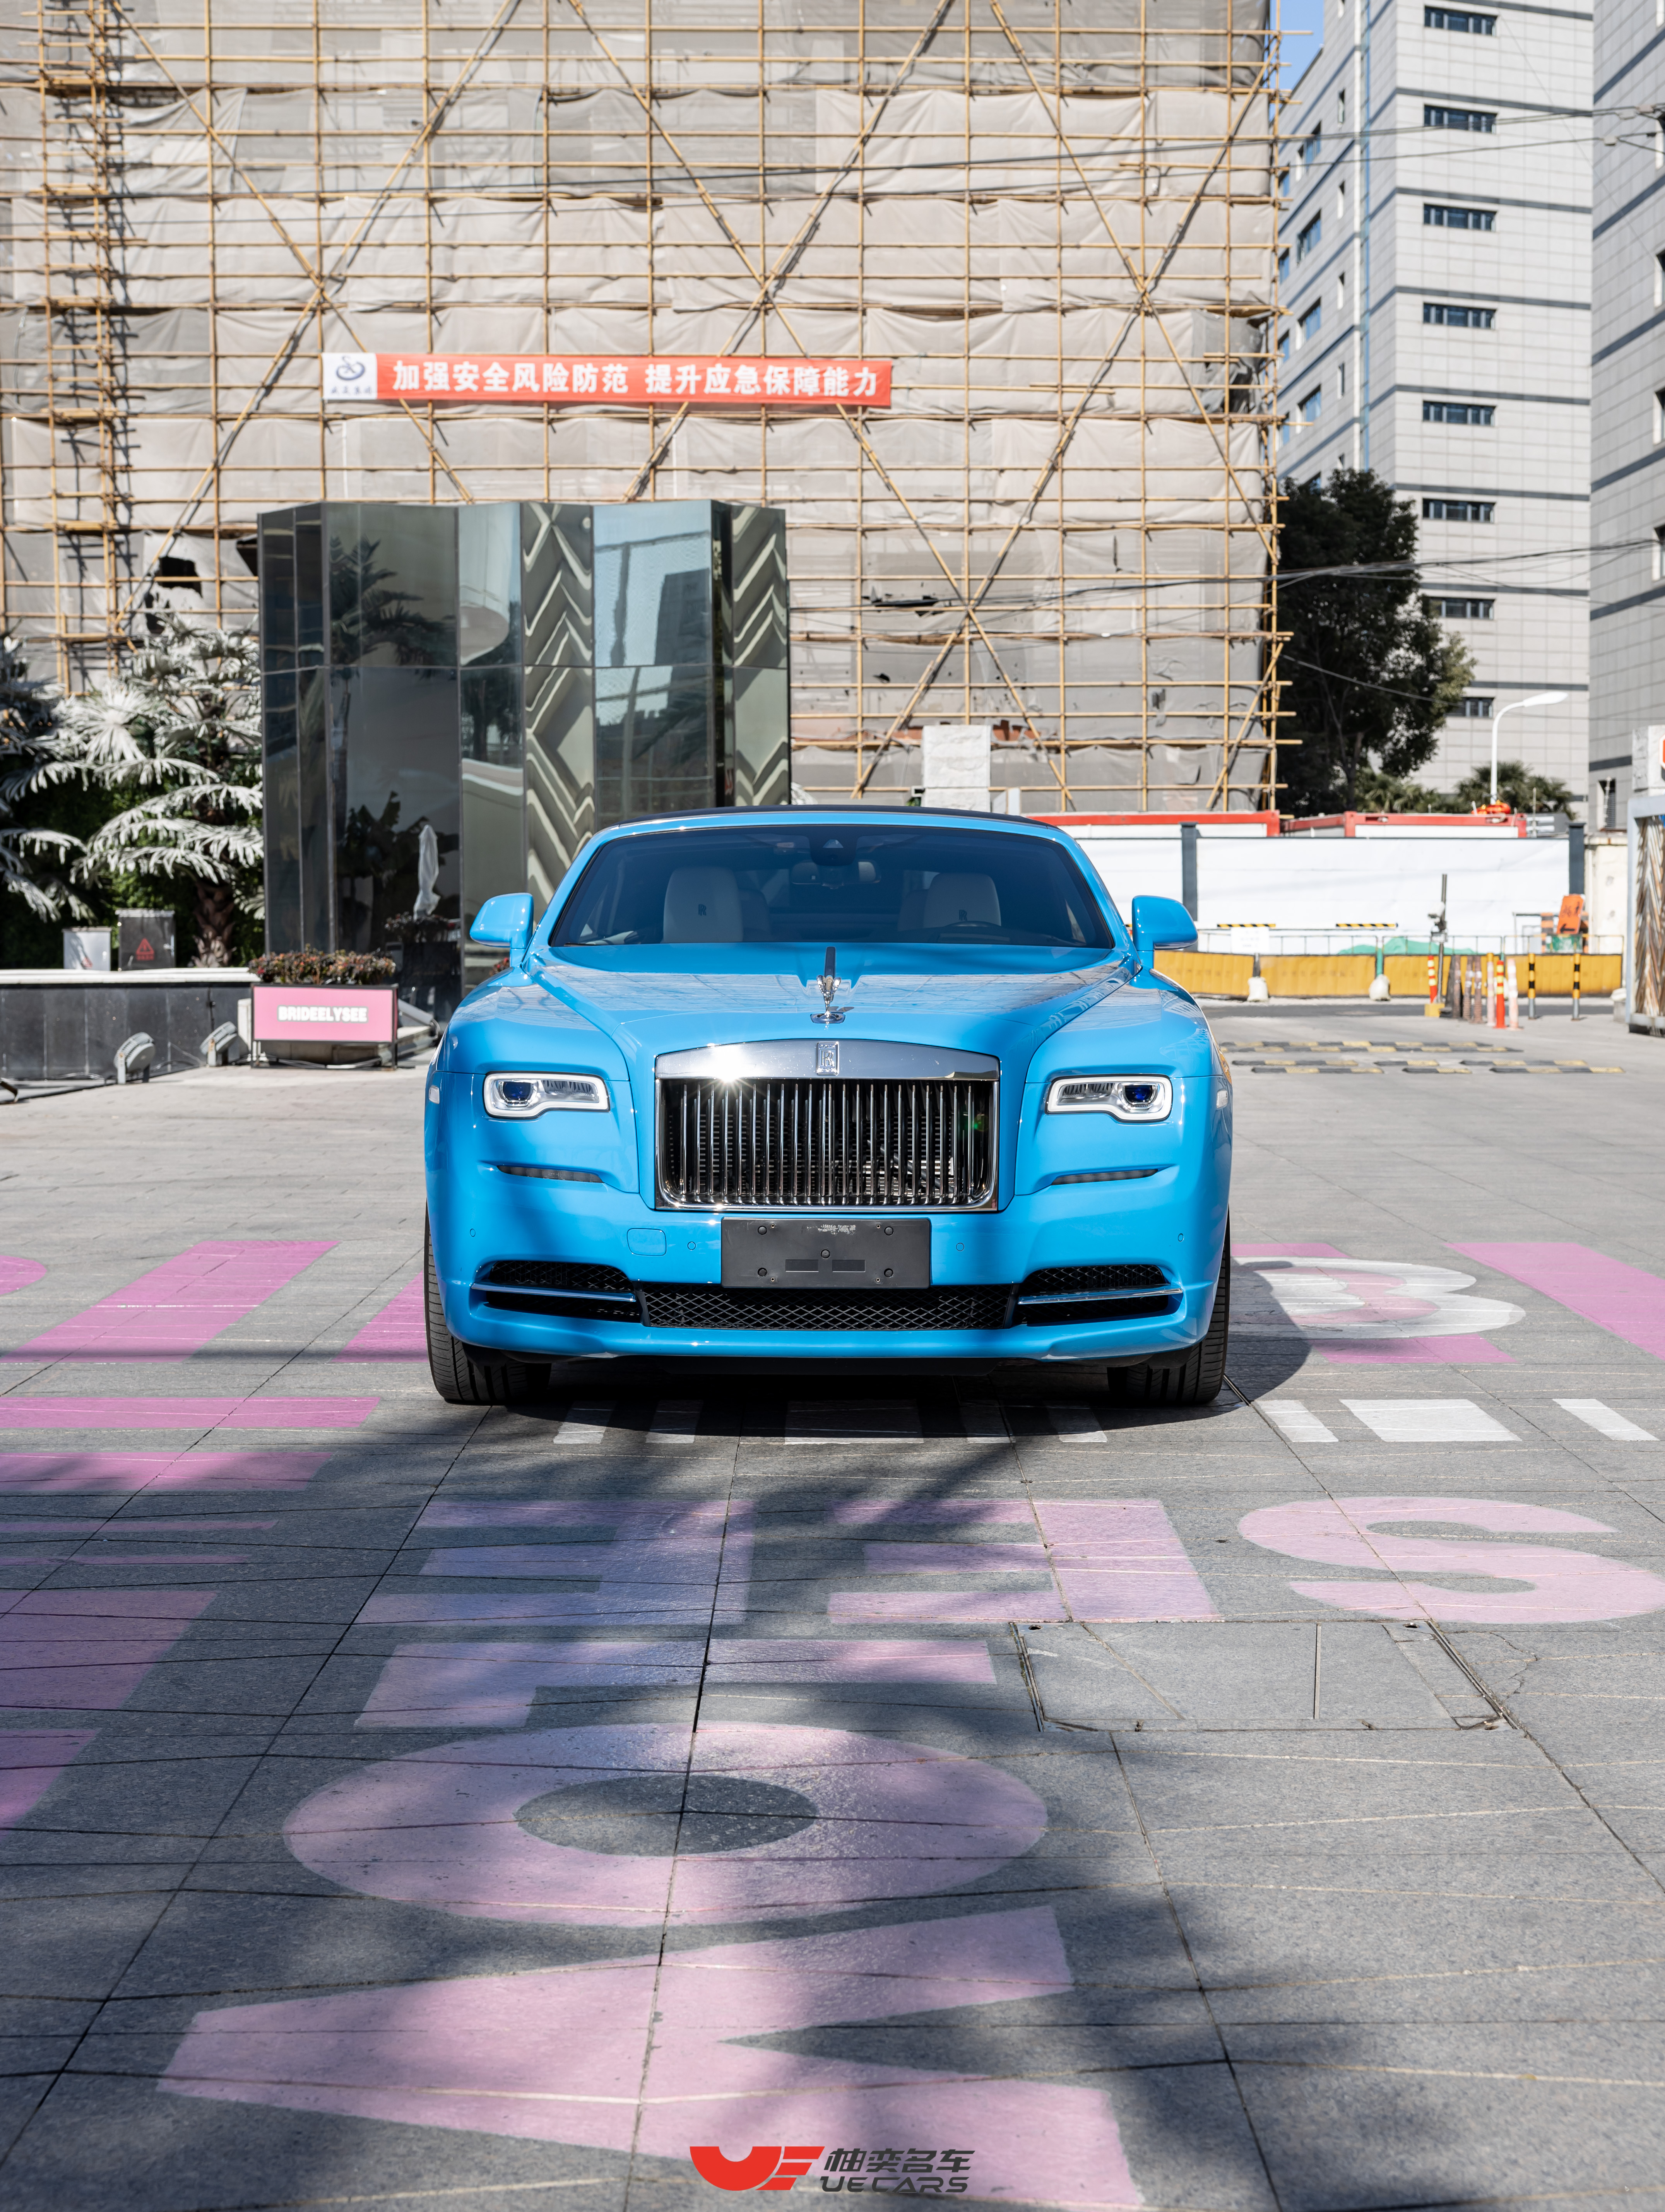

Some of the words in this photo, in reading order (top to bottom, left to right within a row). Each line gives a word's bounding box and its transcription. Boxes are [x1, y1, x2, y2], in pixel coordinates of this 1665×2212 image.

[392, 360, 629, 393] 加强安全风险防范
[644, 363, 877, 397] 提升应急保障能力
[277, 1006, 368, 1023] BRIDEELYSEE
[821, 1050, 835, 1067] RR
